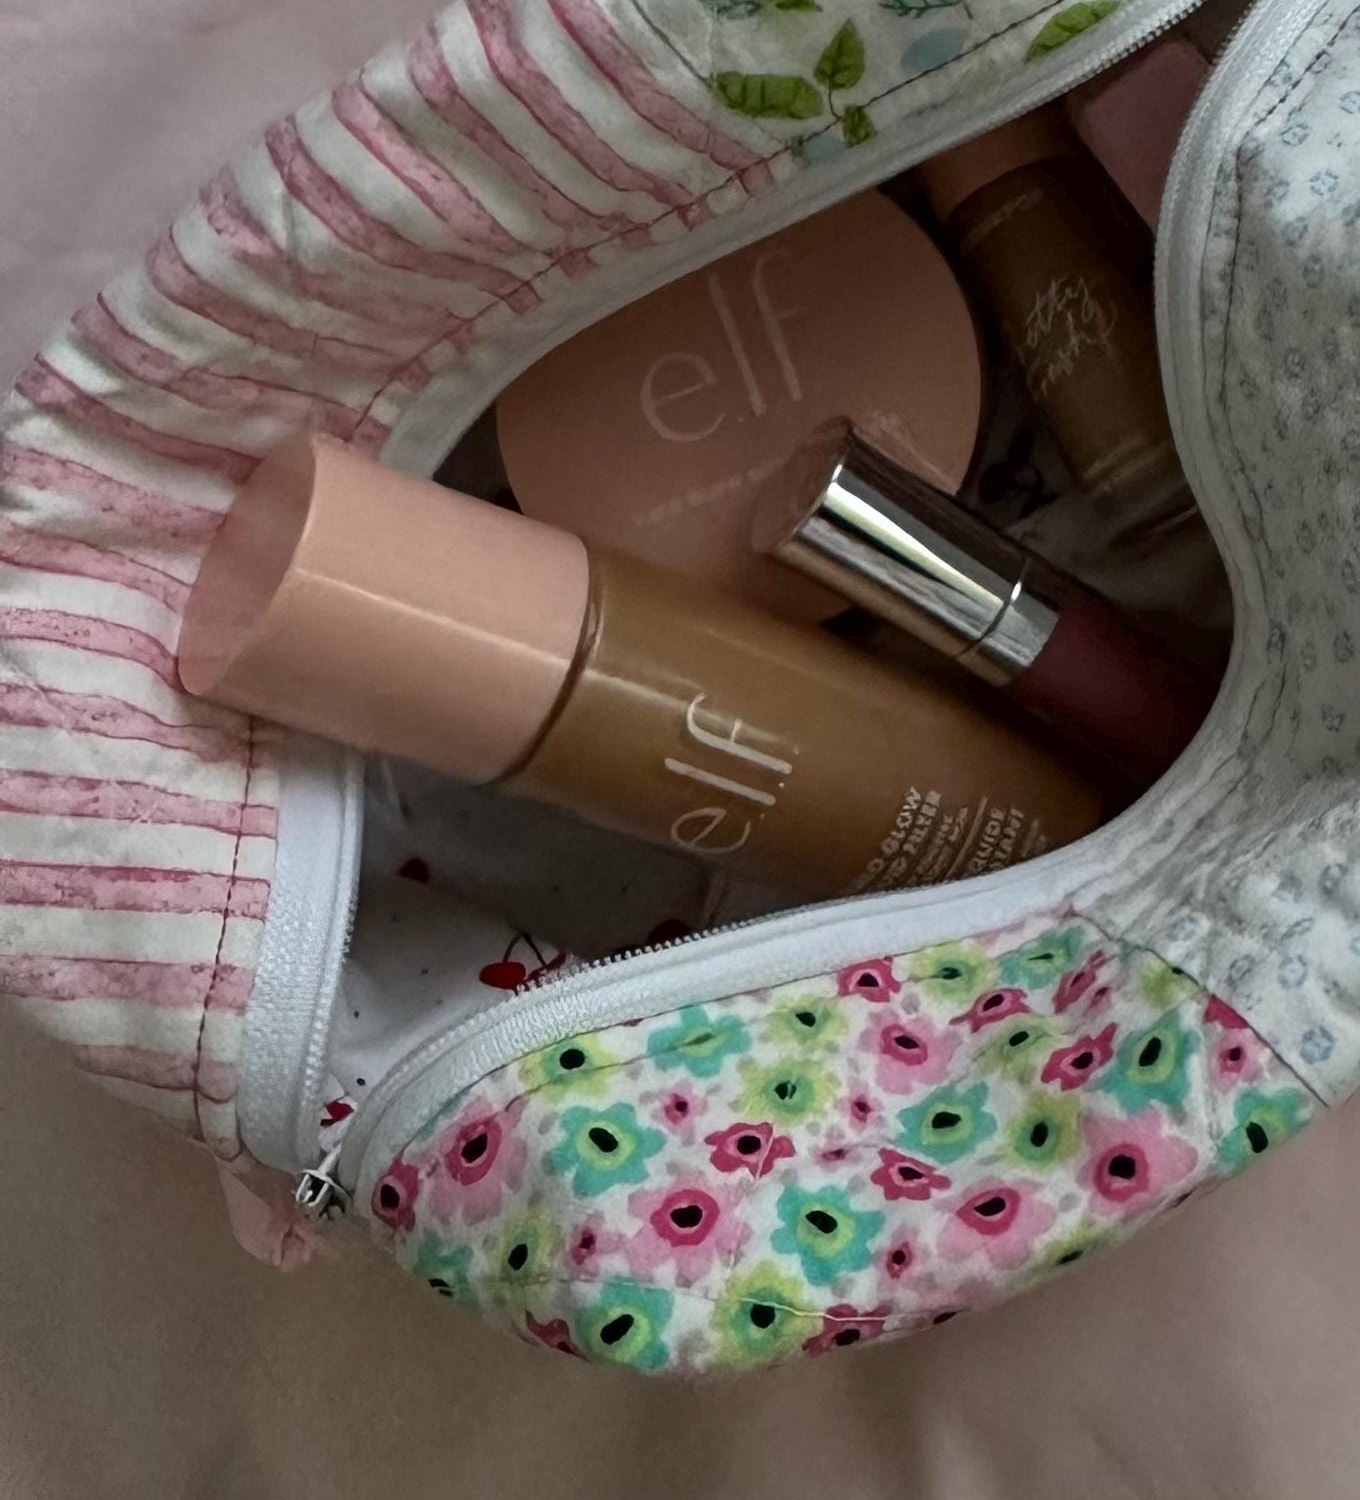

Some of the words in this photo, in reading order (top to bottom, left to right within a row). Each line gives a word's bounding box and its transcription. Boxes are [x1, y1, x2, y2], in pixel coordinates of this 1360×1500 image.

[880, 785, 922, 855] GLOW
[966, 806, 1006, 873] QUIDE
[988, 805, 1024, 869] TANT
